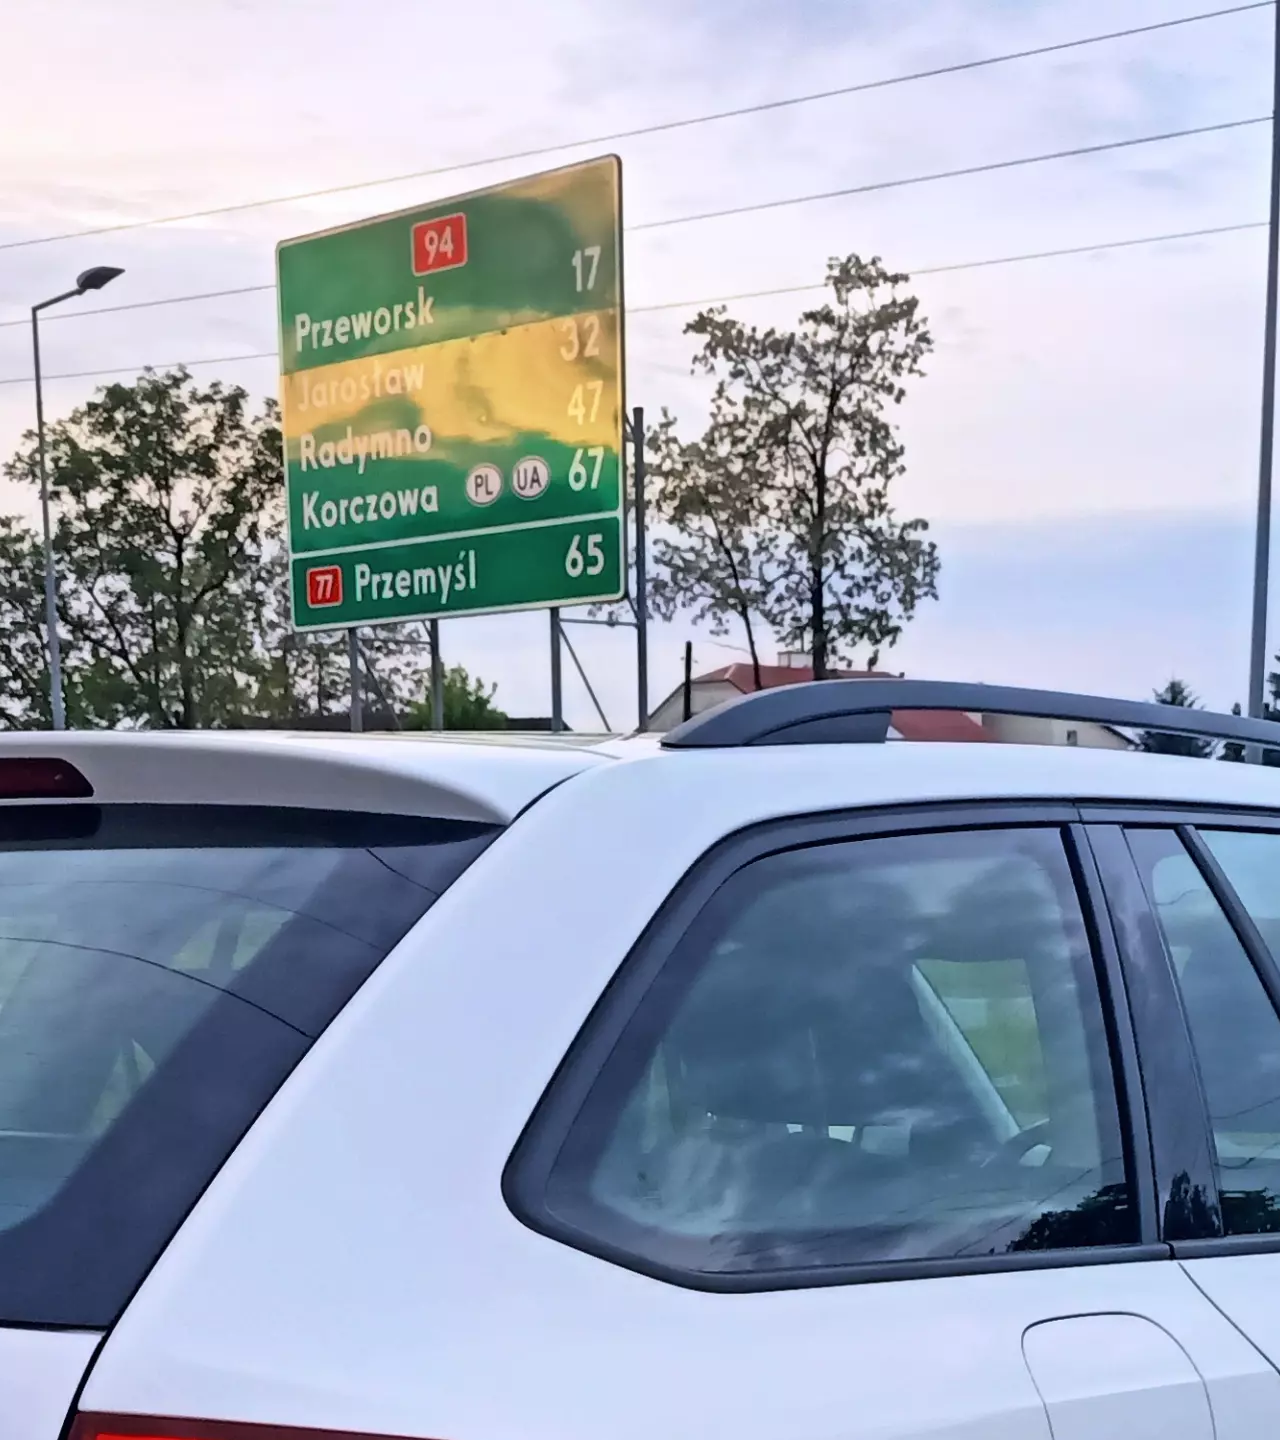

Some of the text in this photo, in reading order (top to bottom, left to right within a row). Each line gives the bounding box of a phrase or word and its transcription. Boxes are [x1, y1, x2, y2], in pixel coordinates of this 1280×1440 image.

[423, 225, 456, 266] 94
[295, 246, 602, 352] Przeworsk 17
[298, 315, 600, 411] Jarosław 32
[300, 381, 604, 474] Radymno 47
[302, 447, 604, 530] Korczowa PL UA 67
[315, 534, 606, 604] 77 Przemyśl 65
